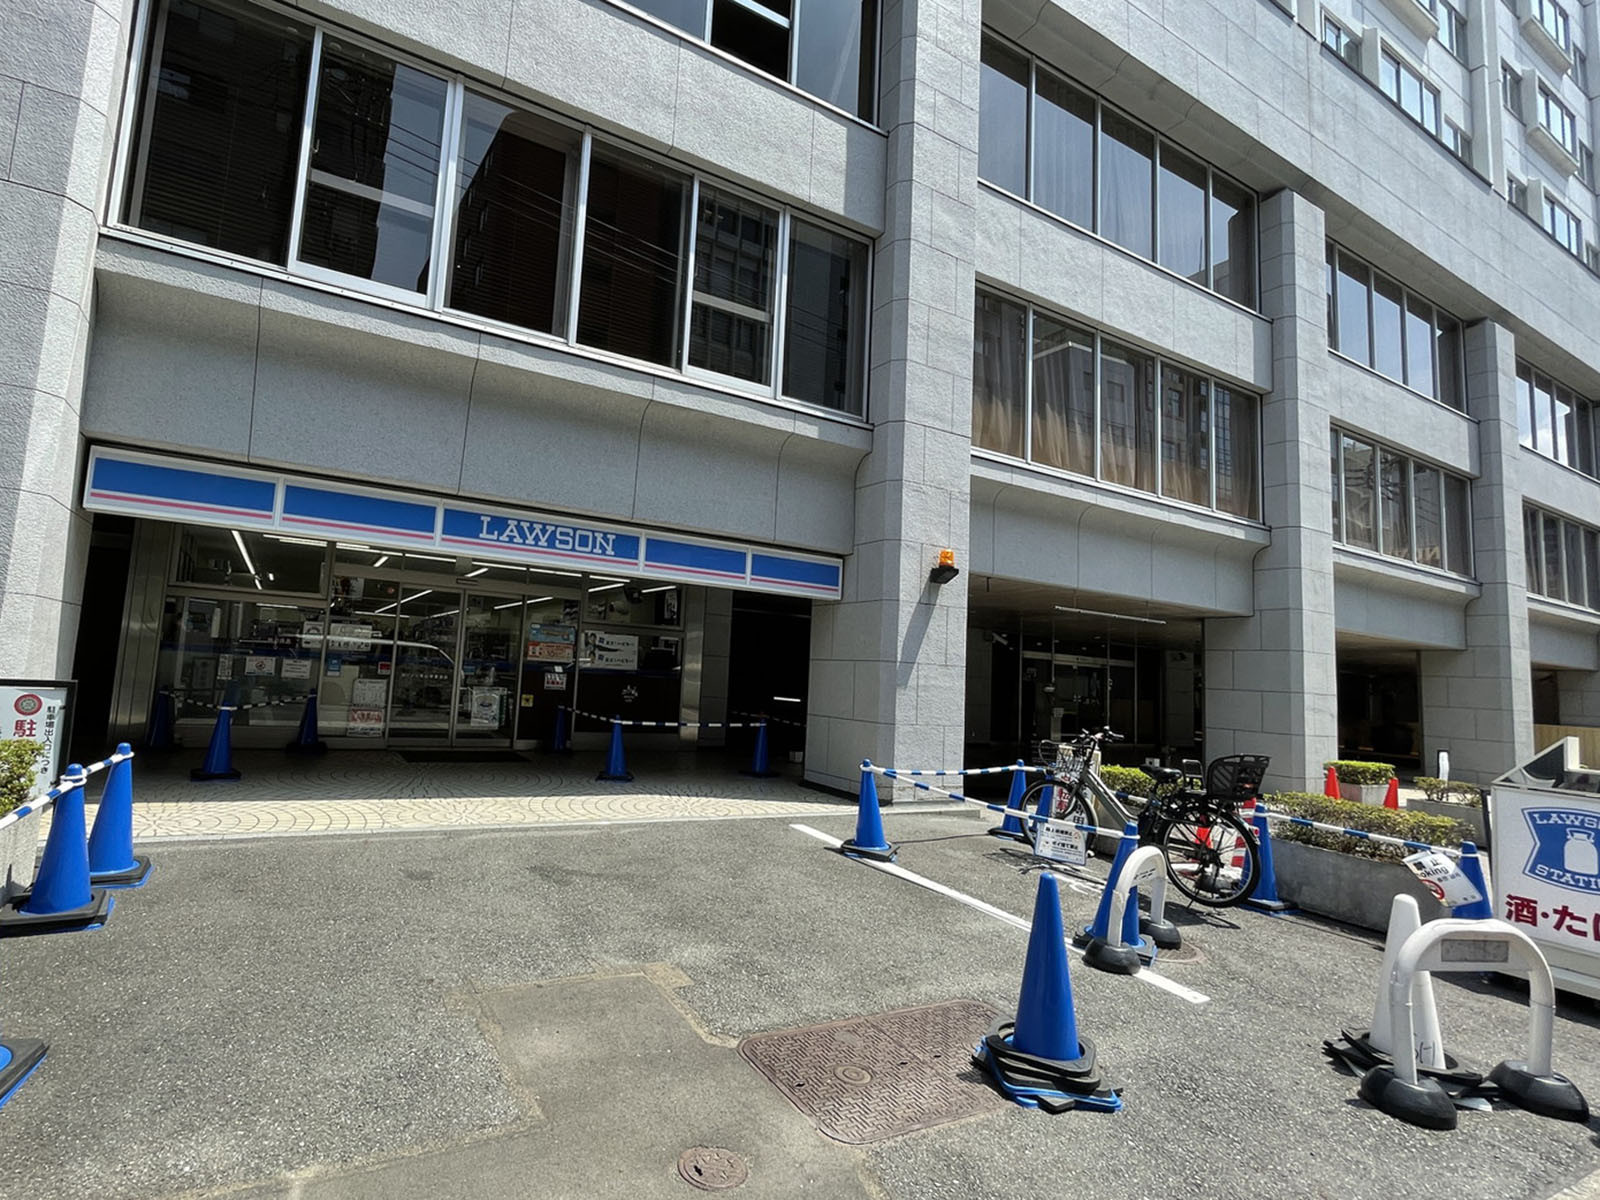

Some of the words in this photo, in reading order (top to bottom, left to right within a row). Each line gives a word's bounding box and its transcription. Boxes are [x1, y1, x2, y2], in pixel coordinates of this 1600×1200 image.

[478, 515, 616, 556] LAWSON
[1533, 813, 1600, 829] LAWS
[1535, 864, 1600, 890] STATI
